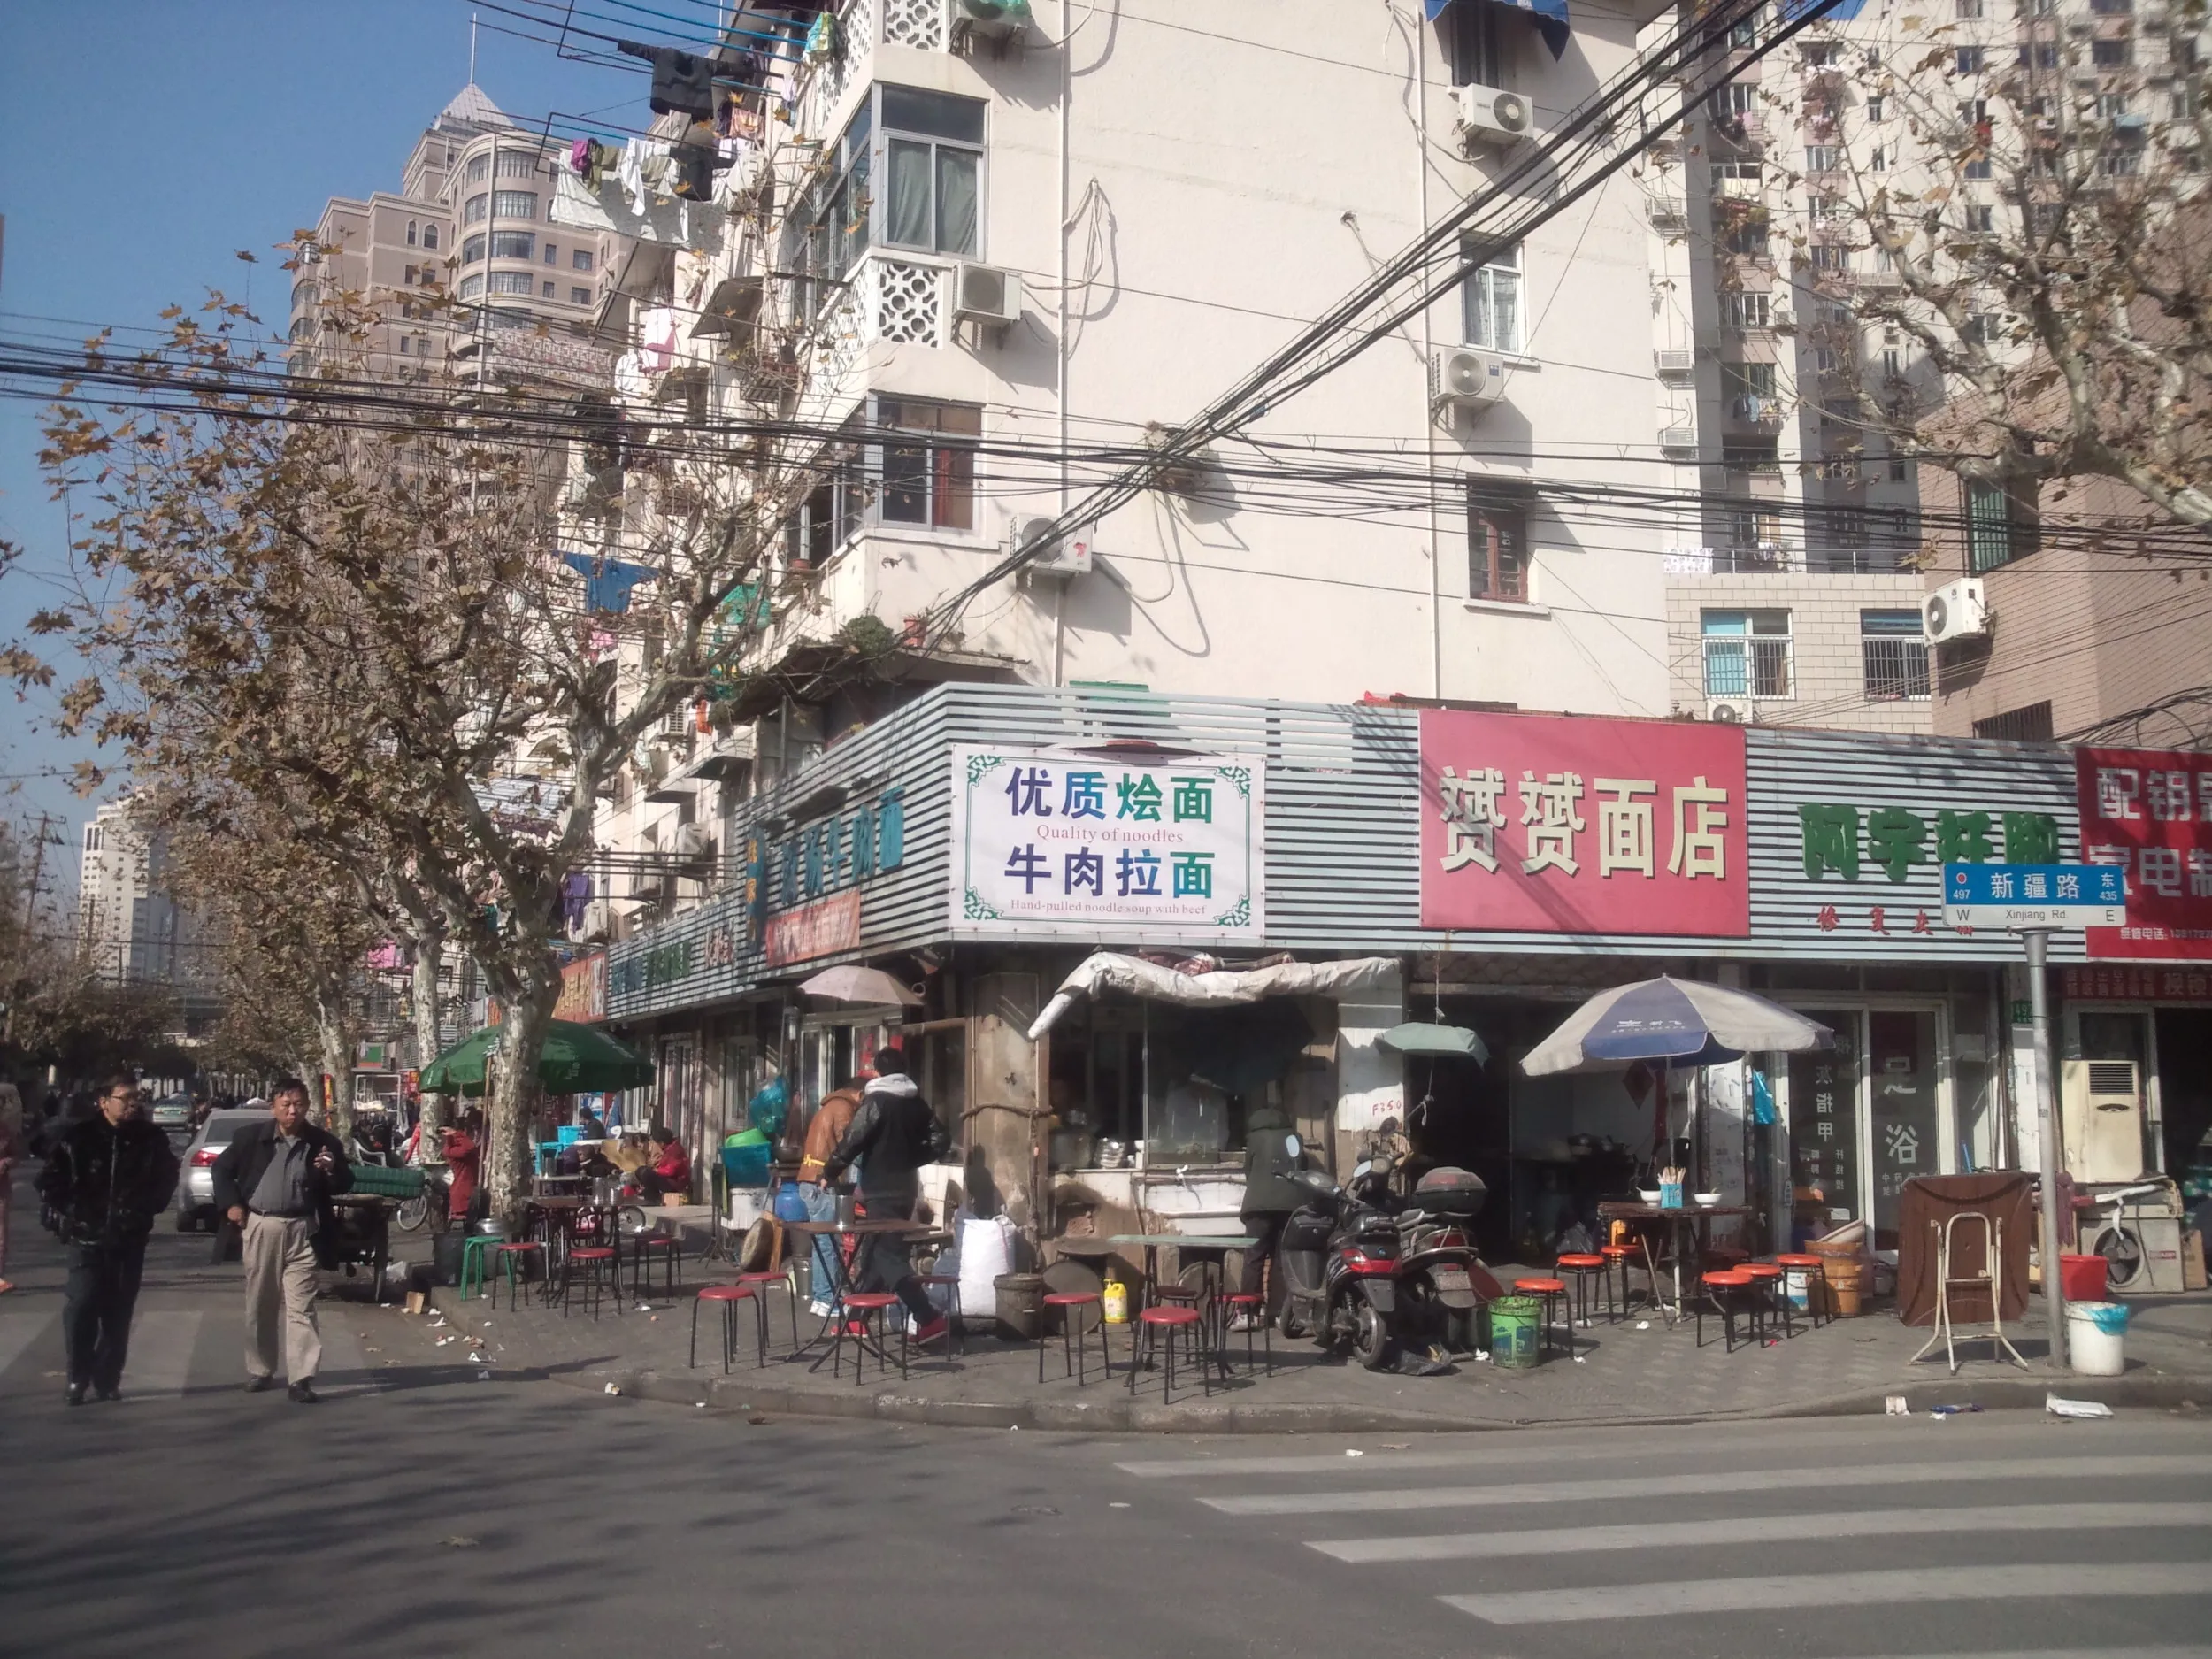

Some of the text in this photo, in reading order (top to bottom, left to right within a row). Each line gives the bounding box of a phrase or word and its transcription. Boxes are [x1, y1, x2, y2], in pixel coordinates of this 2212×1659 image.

[1005, 766, 1216, 824] 优质烩面
[1439, 766, 1730, 881] 赟赟面店
[1037, 824, 1183, 843] Quality of noodles
[1004, 842, 1216, 900] 牛肉拉面
[1991, 872, 2079, 899] 新疆路
[2101, 872, 2115, 887] 东
[1953, 889, 1970, 900] 497
[2099, 891, 2117, 901] 435
[1010, 899, 1206, 915] Hand-pulled noodle soup with beef
[1956, 909, 1970, 921] W
[2006, 910, 2045, 921] Xinjiang
[2106, 910, 2115, 922] E
